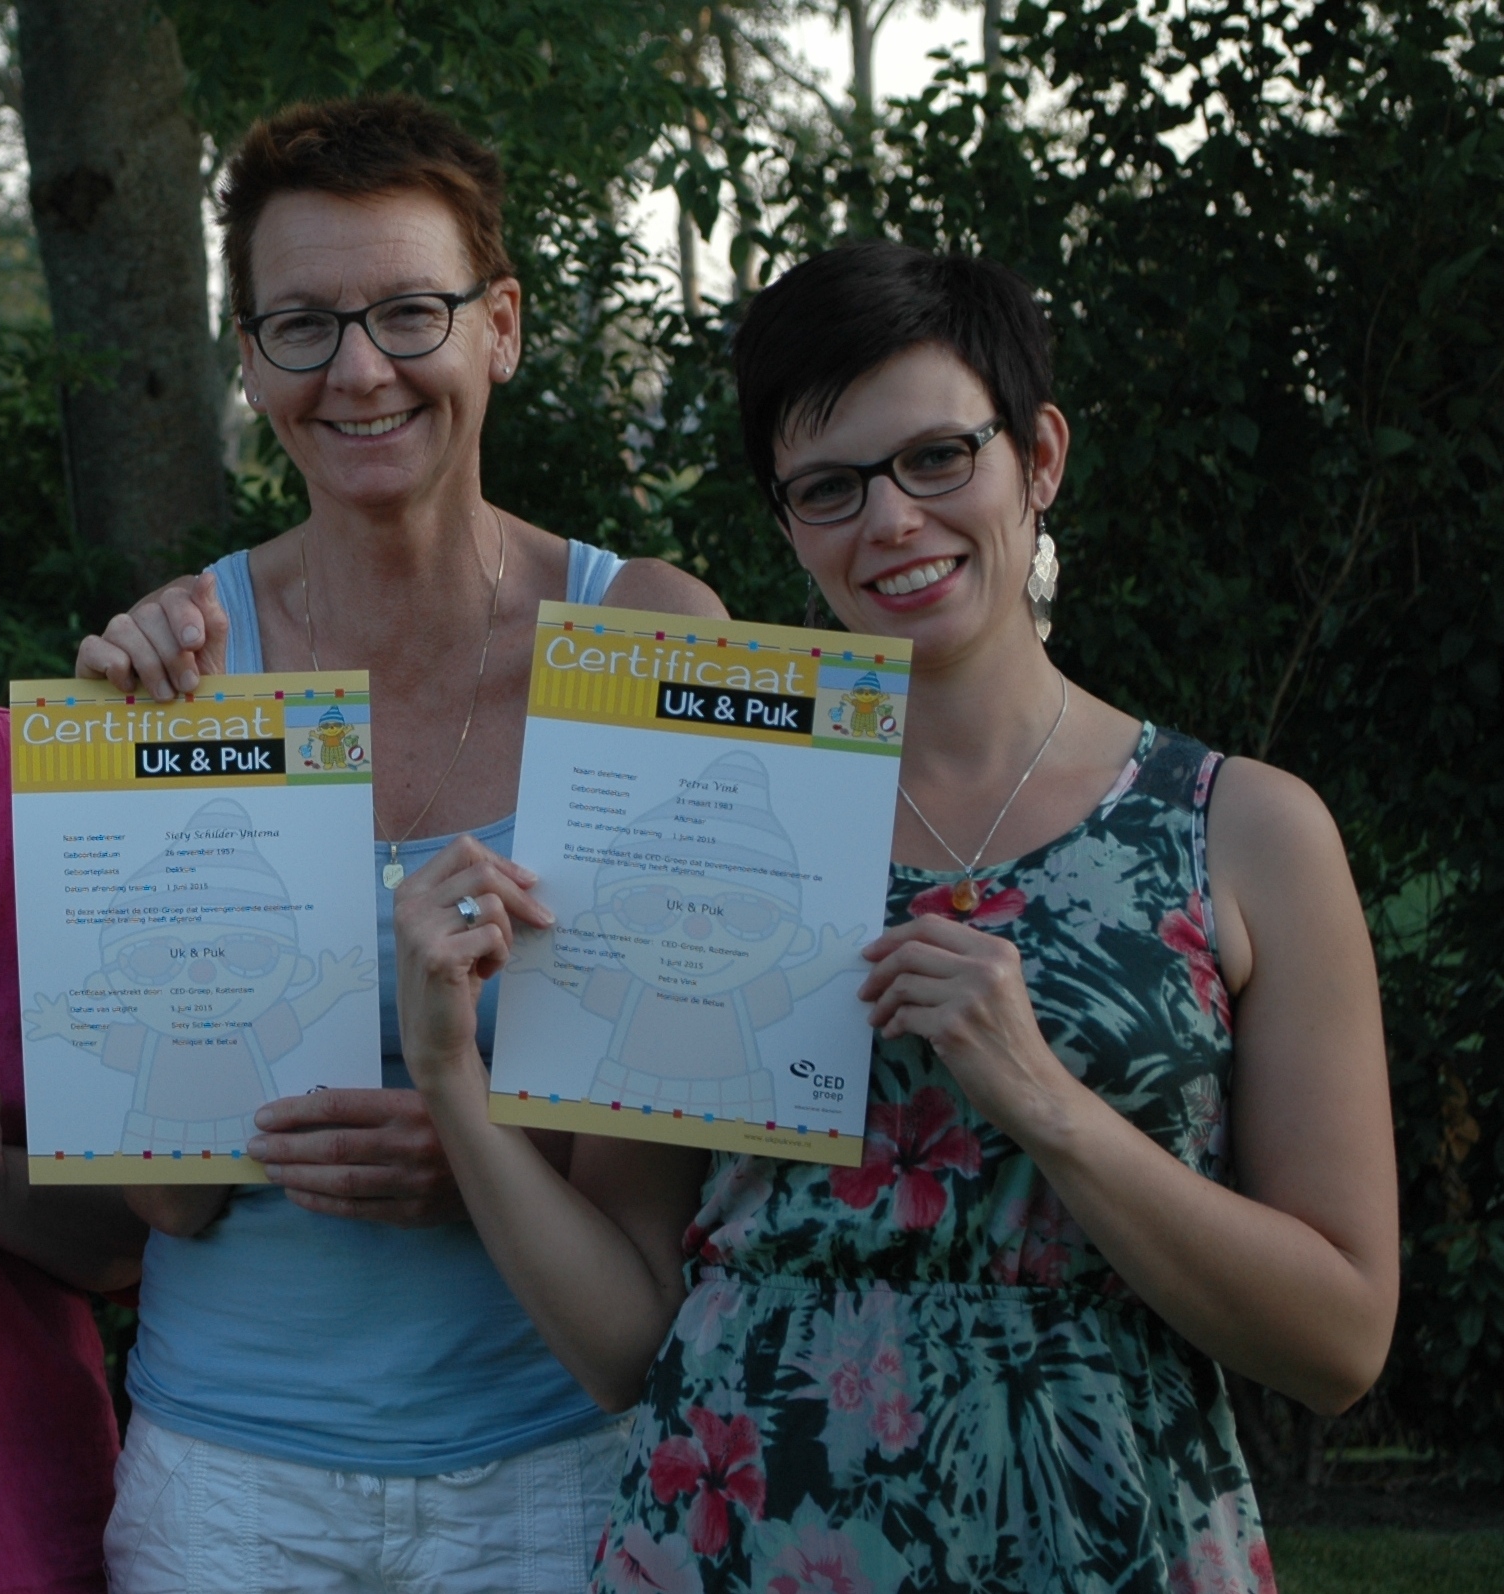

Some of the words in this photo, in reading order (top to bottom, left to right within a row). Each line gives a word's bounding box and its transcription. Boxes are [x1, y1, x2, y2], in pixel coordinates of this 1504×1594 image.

[545, 636, 808, 695] Certificaat
[663, 689, 706, 717] Uk
[713, 694, 736, 721] &
[745, 698, 799, 727] Puk
[22, 707, 273, 744] Certificaat
[142, 748, 181, 773] Uk
[190, 747, 211, 771] &
[220, 745, 271, 770] Puk
[677, 778, 709, 790] Petra
[713, 781, 739, 793] Vink
[696, 835, 716, 844] 2015
[189, 882, 208, 890] 2015
[666, 899, 683, 911] Uk
[687, 901, 696, 913] &
[701, 903, 724, 916] Puk
[169, 948, 185, 958] Uk
[190, 947, 198, 957] &
[203, 947, 225, 957] Puk
[684, 960, 703, 969] 2015
[812, 1073, 845, 1090] CED
[811, 1090, 844, 1102] groep
